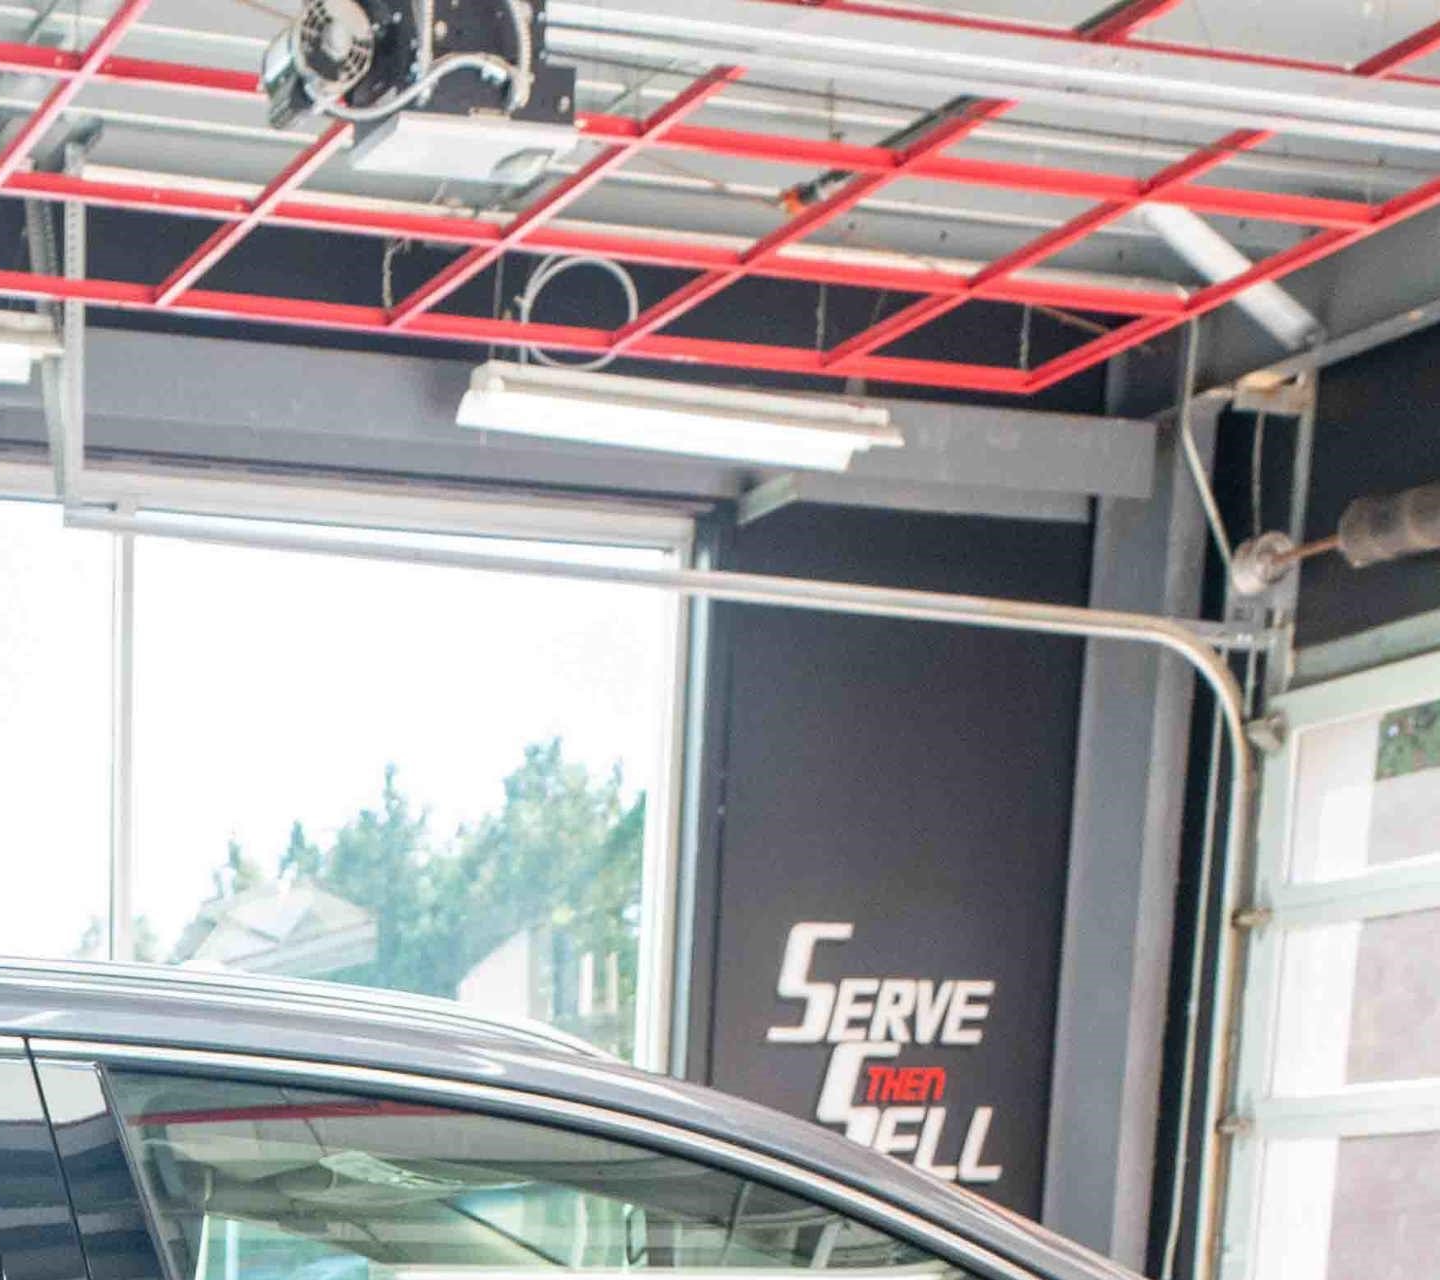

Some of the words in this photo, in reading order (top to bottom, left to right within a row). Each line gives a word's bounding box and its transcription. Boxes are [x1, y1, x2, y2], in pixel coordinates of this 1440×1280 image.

[766, 922, 996, 1045] SERVE
[816, 1042, 1004, 1183] SELL
[865, 1065, 948, 1102] THEN
